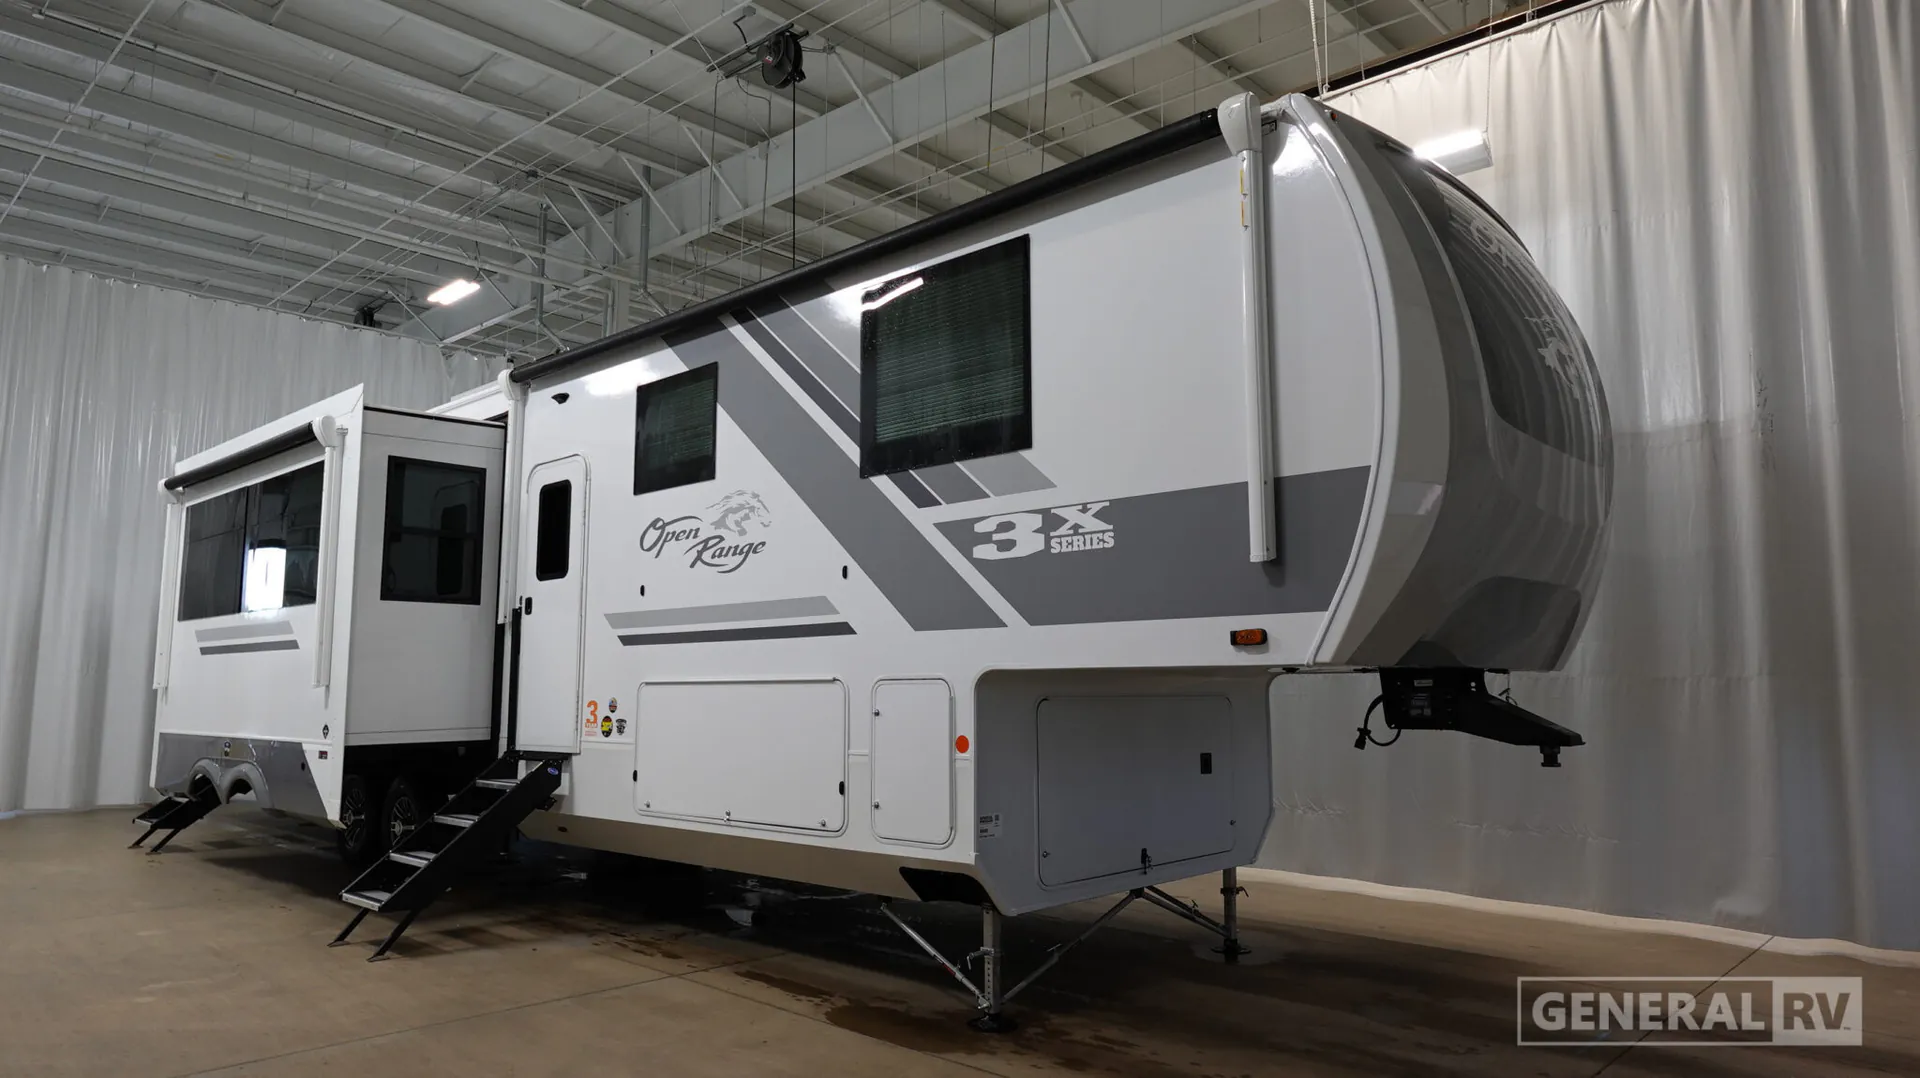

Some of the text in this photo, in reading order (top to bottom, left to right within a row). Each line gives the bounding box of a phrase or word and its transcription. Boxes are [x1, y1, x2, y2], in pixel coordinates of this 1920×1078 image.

[640, 516, 703, 558] Open
[1050, 532, 1115, 553] SERIES
[683, 535, 766, 573] Range
[586, 700, 598, 724] 3
